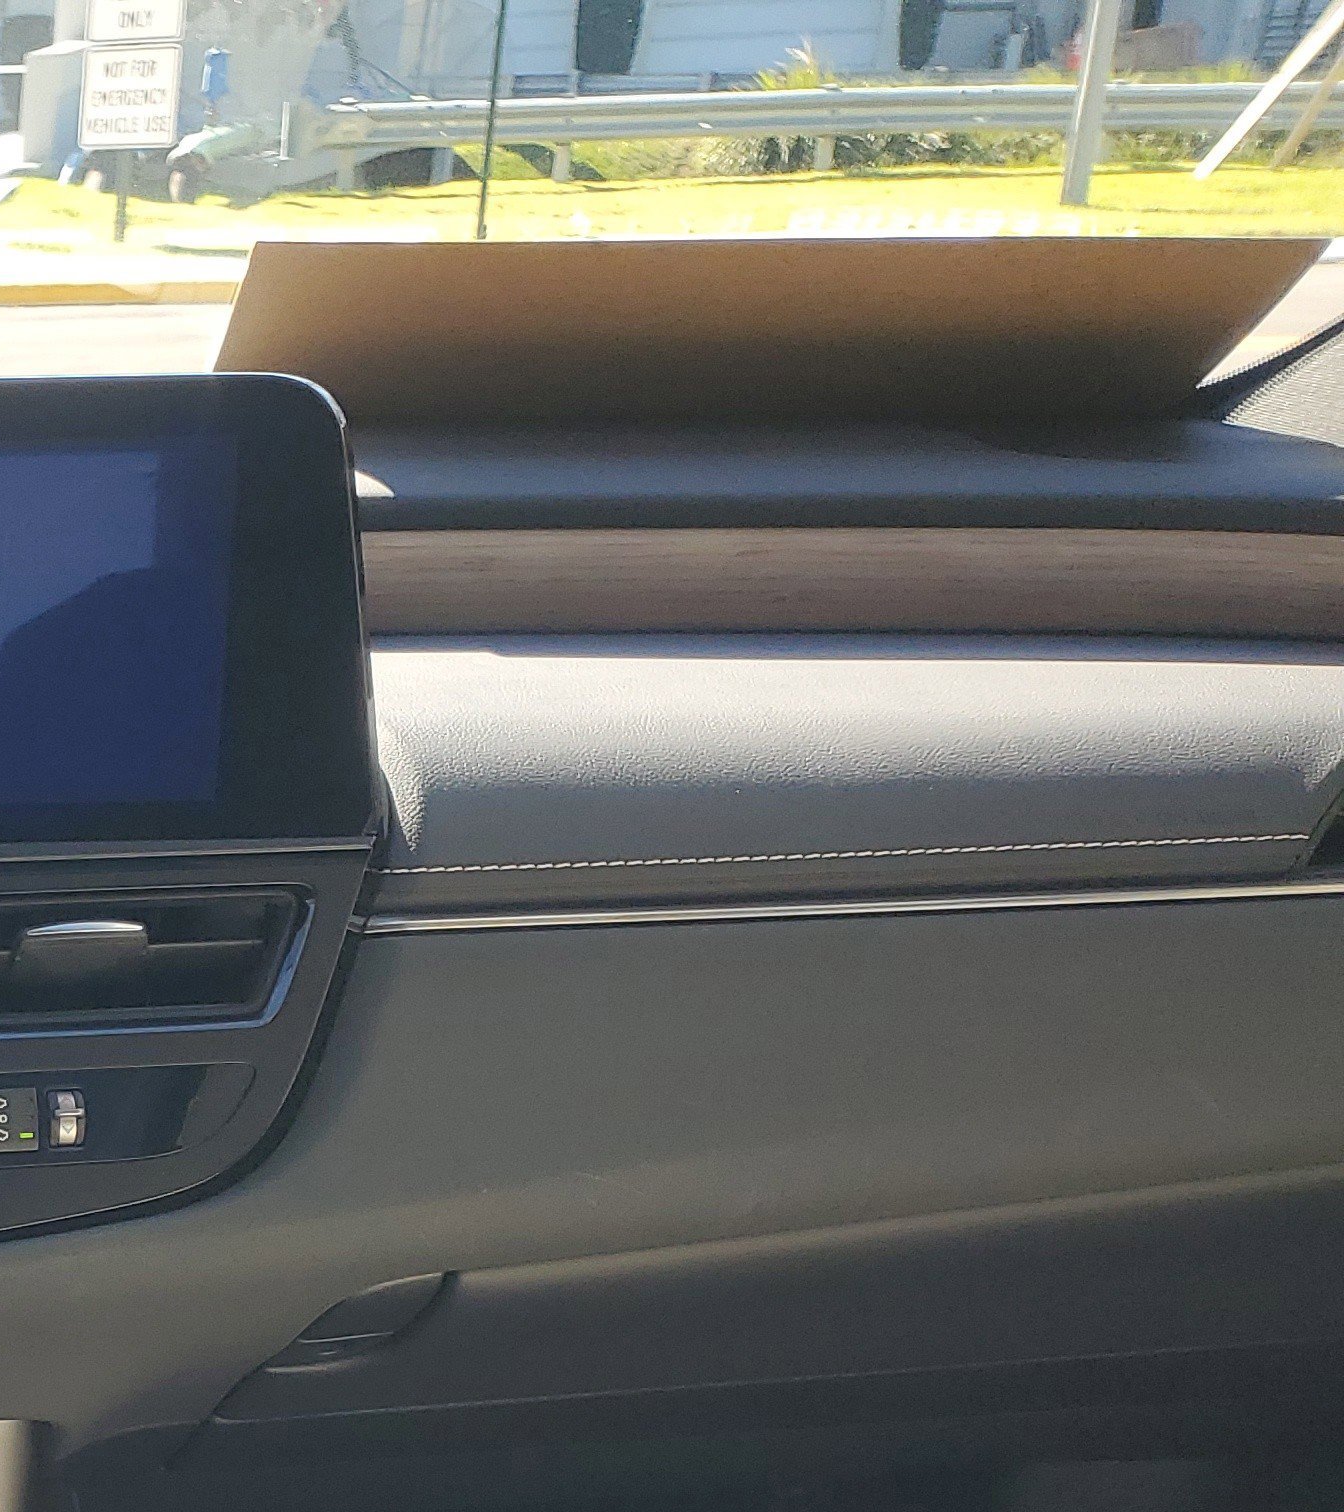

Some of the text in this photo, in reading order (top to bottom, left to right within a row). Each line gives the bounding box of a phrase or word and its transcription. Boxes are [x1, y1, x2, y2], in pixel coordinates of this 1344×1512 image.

[117, 10, 155, 28] ONLY
[103, 59, 157, 78] NOT FOR
[91, 88, 167, 107] EMERGENCY
[85, 116, 140, 134] VEHICLE
